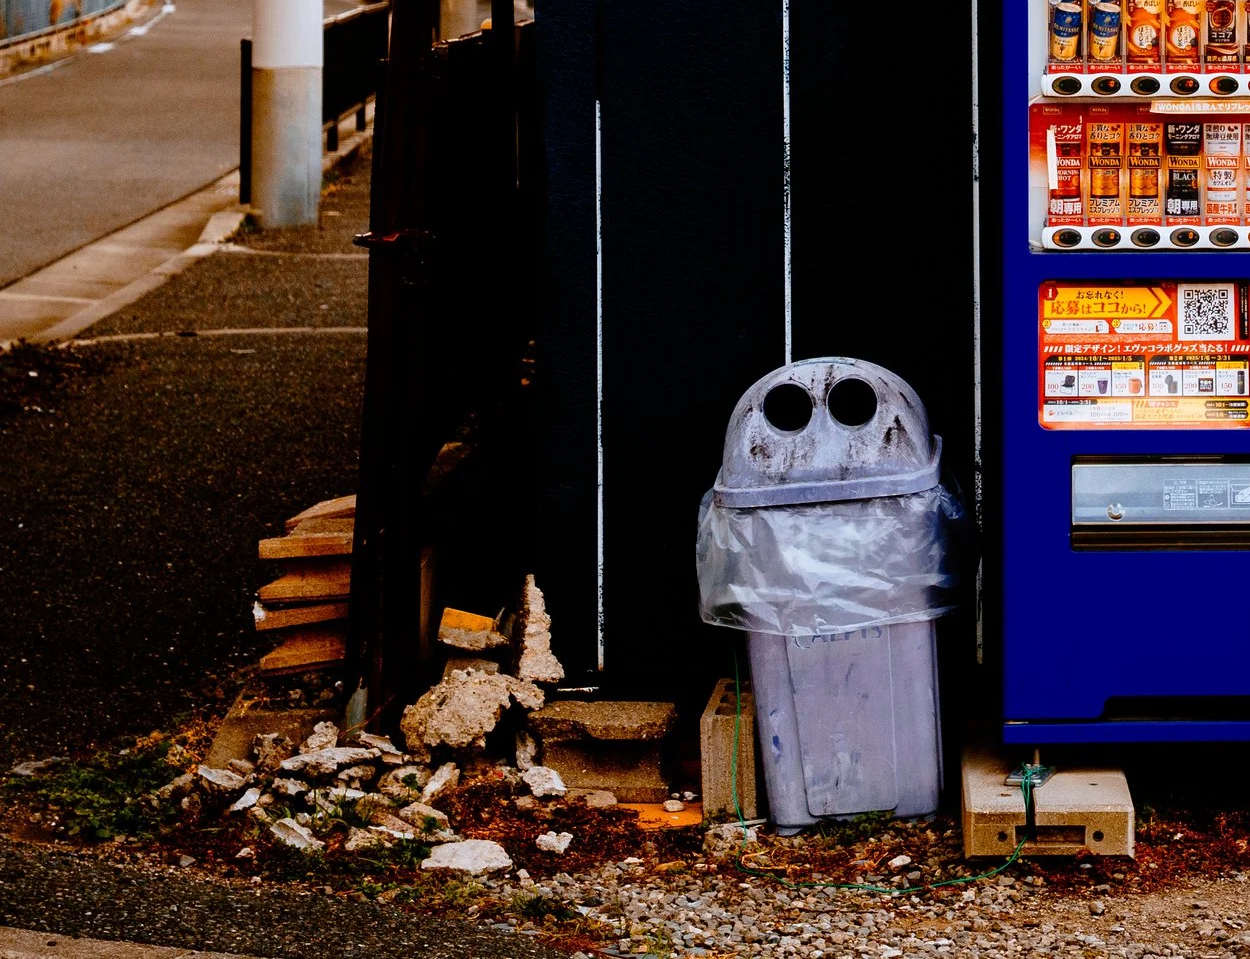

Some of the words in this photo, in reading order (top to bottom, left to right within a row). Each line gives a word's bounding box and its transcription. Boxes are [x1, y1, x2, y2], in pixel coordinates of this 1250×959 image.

[1090, 124, 1109, 132] 上質な
[1129, 124, 1148, 132] 上質な
[1167, 124, 1200, 134] 新・ワンダ
[1206, 124, 1226, 133] 深煎り
[1206, 133, 1239, 141] 珈琲豆使用
[1091, 157, 1120, 166] WONDA
[1130, 157, 1159, 166] WONDA
[1169, 156, 1198, 166] WONDA
[1208, 157, 1237, 166] WONDA
[1173, 173, 1196, 181] BLACK
[1213, 171, 1233, 180] 特製
[1050, 199, 1082, 215] 朝専用
[1090, 199, 1120, 207] プレミアム
[1129, 199, 1159, 207] プレミアム
[1167, 199, 1198, 215] 朝専用
[1206, 203, 1233, 214] 国産牛乳
[1075, 290, 1124, 299] お忘れなく!
[1051, 300, 1146, 315] 応募はココから!
[1064, 344, 1120, 353] 限定デザイン!
